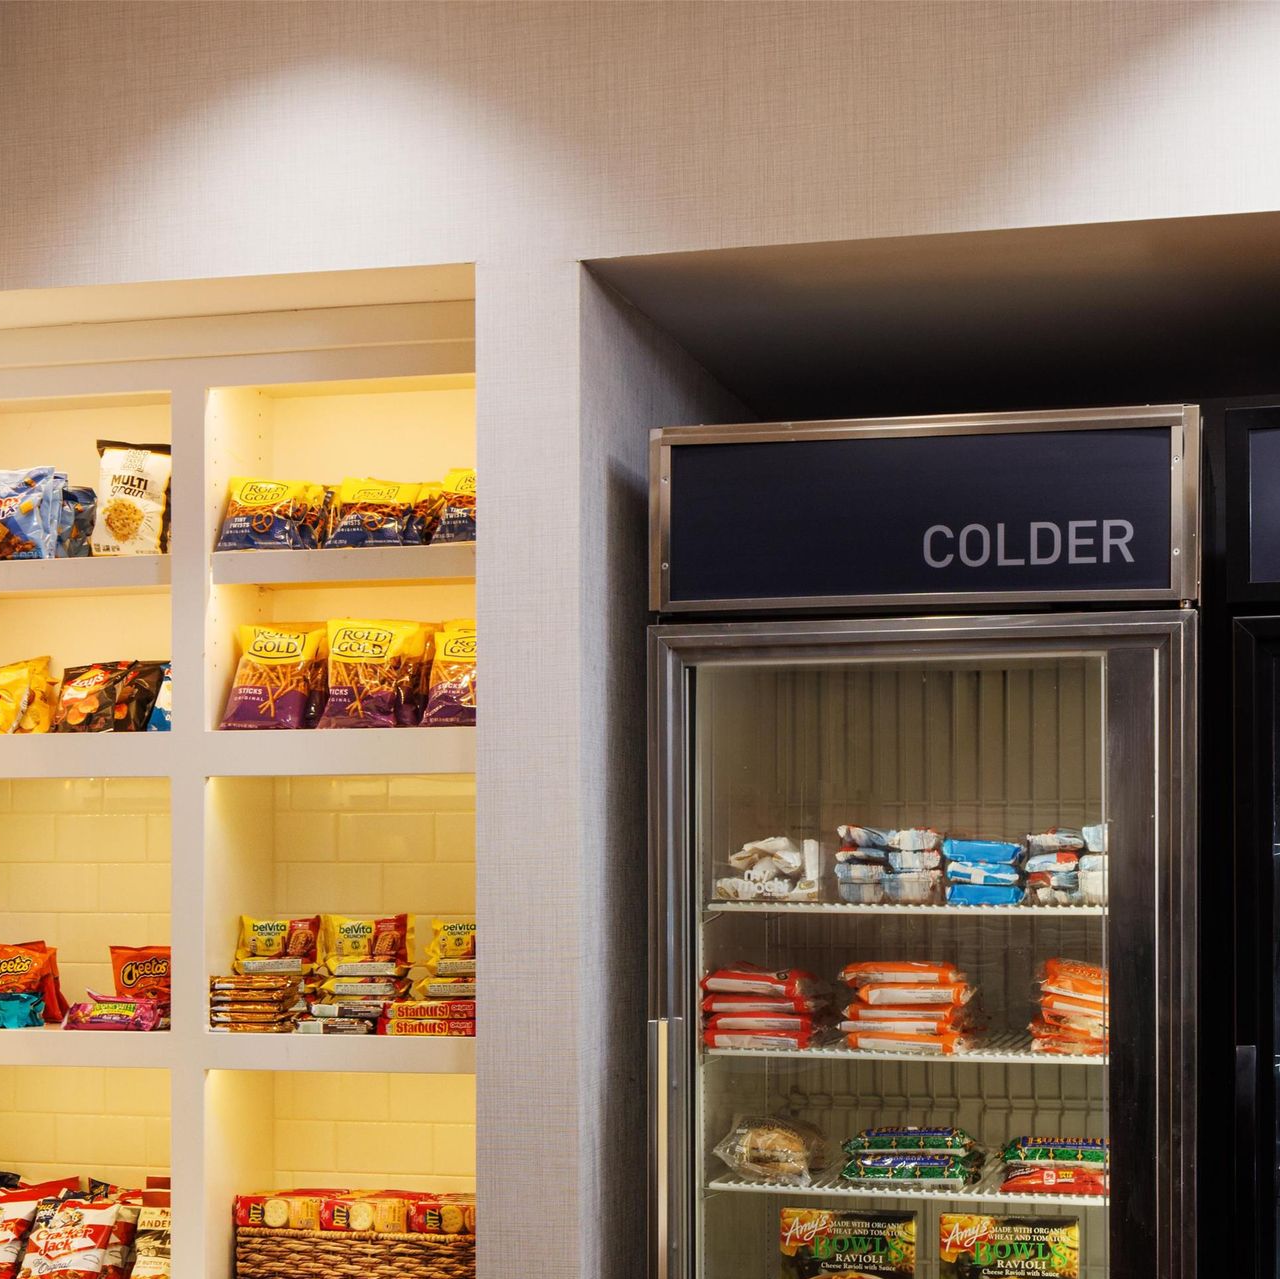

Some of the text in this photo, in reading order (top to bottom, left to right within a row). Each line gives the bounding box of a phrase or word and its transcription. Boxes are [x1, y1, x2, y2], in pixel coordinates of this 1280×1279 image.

[111, 474, 149, 490] MULTI
[111, 485, 145, 498] grain
[244, 492, 281, 501] GOLD
[922, 519, 1135, 569] COLDER
[341, 630, 387, 642] ROLD
[252, 640, 298, 654] GOLD
[337, 641, 383, 655] GOLD
[70, 673, 106, 688] Lay's
[122, 957, 169, 986] Cheetos
[397, 1005, 450, 1018] Starburst
[395, 1022, 448, 1034] Starburst
[248, 1202, 264, 1224] RITZ
[333, 1204, 349, 1226] RITZ
[426, 1208, 441, 1230] RITZ
[783, 1213, 830, 1246] Amy's
[830, 1220, 850, 1228] MADE
[1013, 1226, 1032, 1234] WITH
[36, 1226, 94, 1241] Cracker
[827, 1228, 853, 1236] WHEAT
[853, 1228, 869, 1236] AND
[943, 1219, 989, 1253] Amy's
[988, 1233, 1014, 1241] WHEAT
[39, 1240, 73, 1256] Jack
[811, 1235, 905, 1263] BOWLS
[972, 1241, 1068, 1268] BOWLS
[835, 1253, 883, 1264] RAVIOLI
[996, 1259, 1047, 1270] RAVIOLI
[38, 1261, 73, 1274] Original
[982, 1268, 1004, 1276] Cheese
